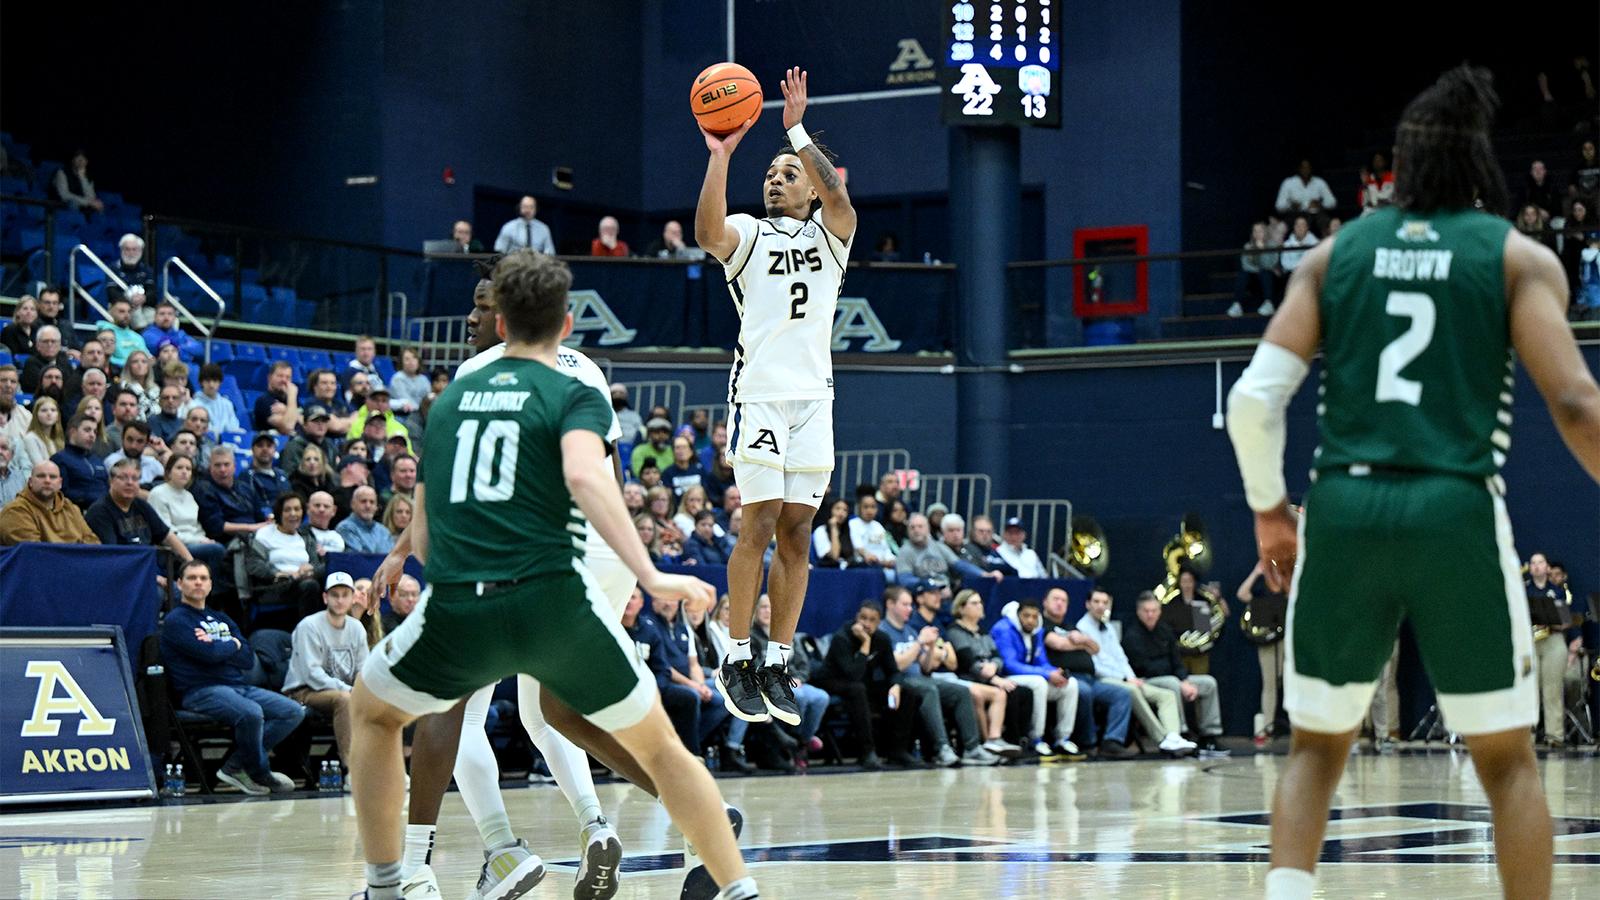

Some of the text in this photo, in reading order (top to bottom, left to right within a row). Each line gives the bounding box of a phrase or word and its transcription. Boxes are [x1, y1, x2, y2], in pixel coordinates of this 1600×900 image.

[952, 3, 1050, 25] 10 2 0 1
[990, 23, 1003, 41] 2
[1016, 24, 1026, 42] 1
[1039, 26, 1051, 44] 2
[889, 38, 935, 71] A
[989, 43, 1003, 61] 4
[1015, 44, 1027, 62] 0
[1039, 46, 1051, 64] 0
[886, 70, 936, 85] AKRON
[962, 93, 1047, 119] 22 13
[768, 246, 823, 276] ZIPS
[1372, 247, 1453, 281] BROWN
[790, 282, 809, 320] 2
[1374, 290, 1437, 407] 2
[747, 428, 781, 456] A
[449, 418, 521, 504] 10
[20, 660, 117, 737] A
[21, 746, 131, 774] AKRON
